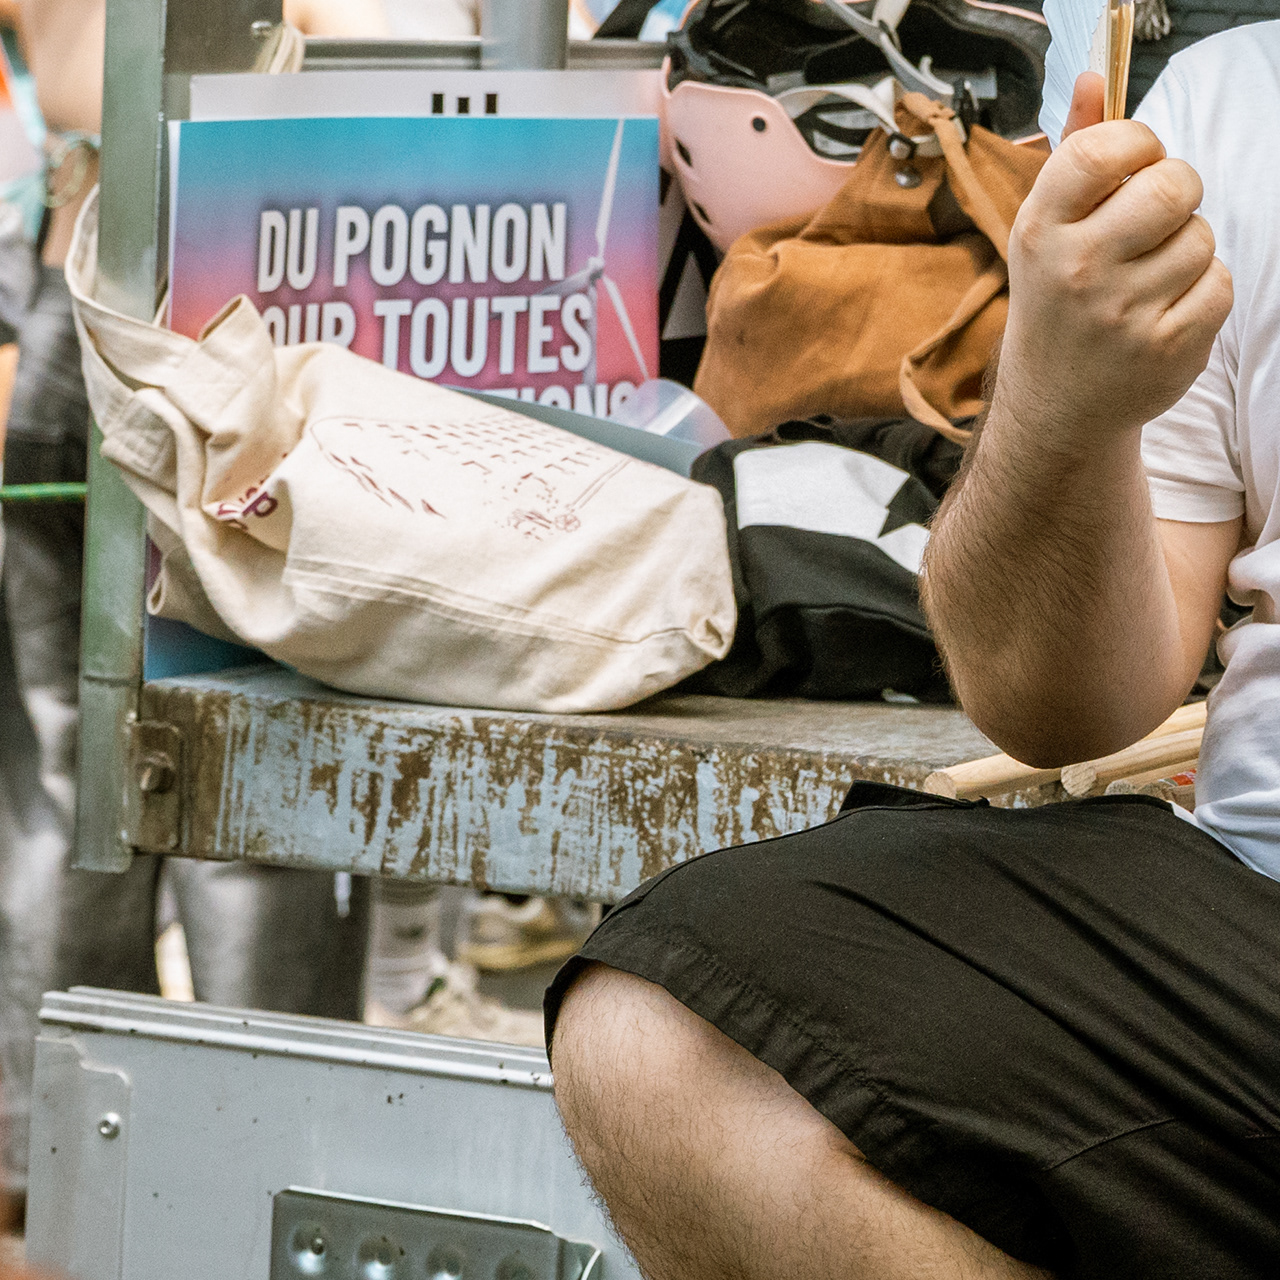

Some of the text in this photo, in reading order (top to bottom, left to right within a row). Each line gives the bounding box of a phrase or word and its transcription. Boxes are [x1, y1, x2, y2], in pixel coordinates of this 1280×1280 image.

[257, 206, 320, 294] DU
[332, 202, 567, 287] POGNON
[373, 293, 594, 379] TOUTES
